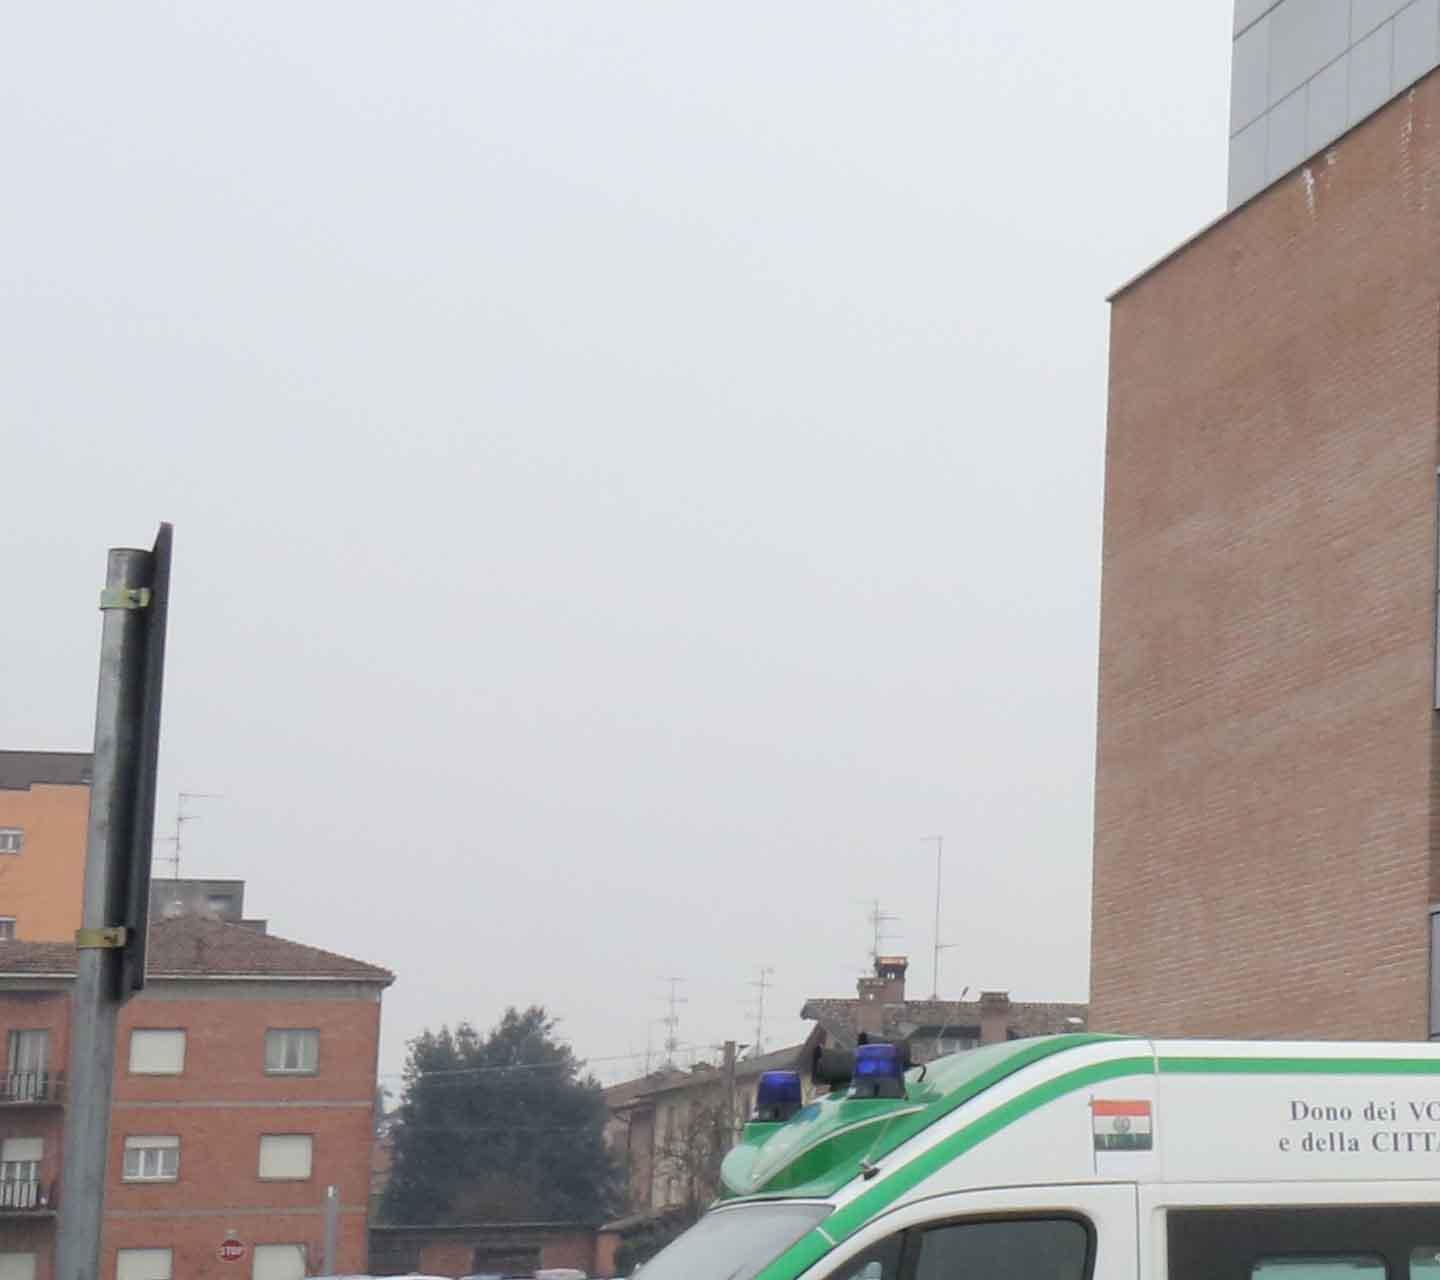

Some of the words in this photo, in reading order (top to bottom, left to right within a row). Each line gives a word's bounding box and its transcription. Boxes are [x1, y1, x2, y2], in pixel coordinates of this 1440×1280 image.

[1289, 1100, 1353, 1121] Dono
[1363, 1101, 1398, 1121] dei
[1278, 1137, 1291, 1152] e
[1301, 1132, 1360, 1152] della
